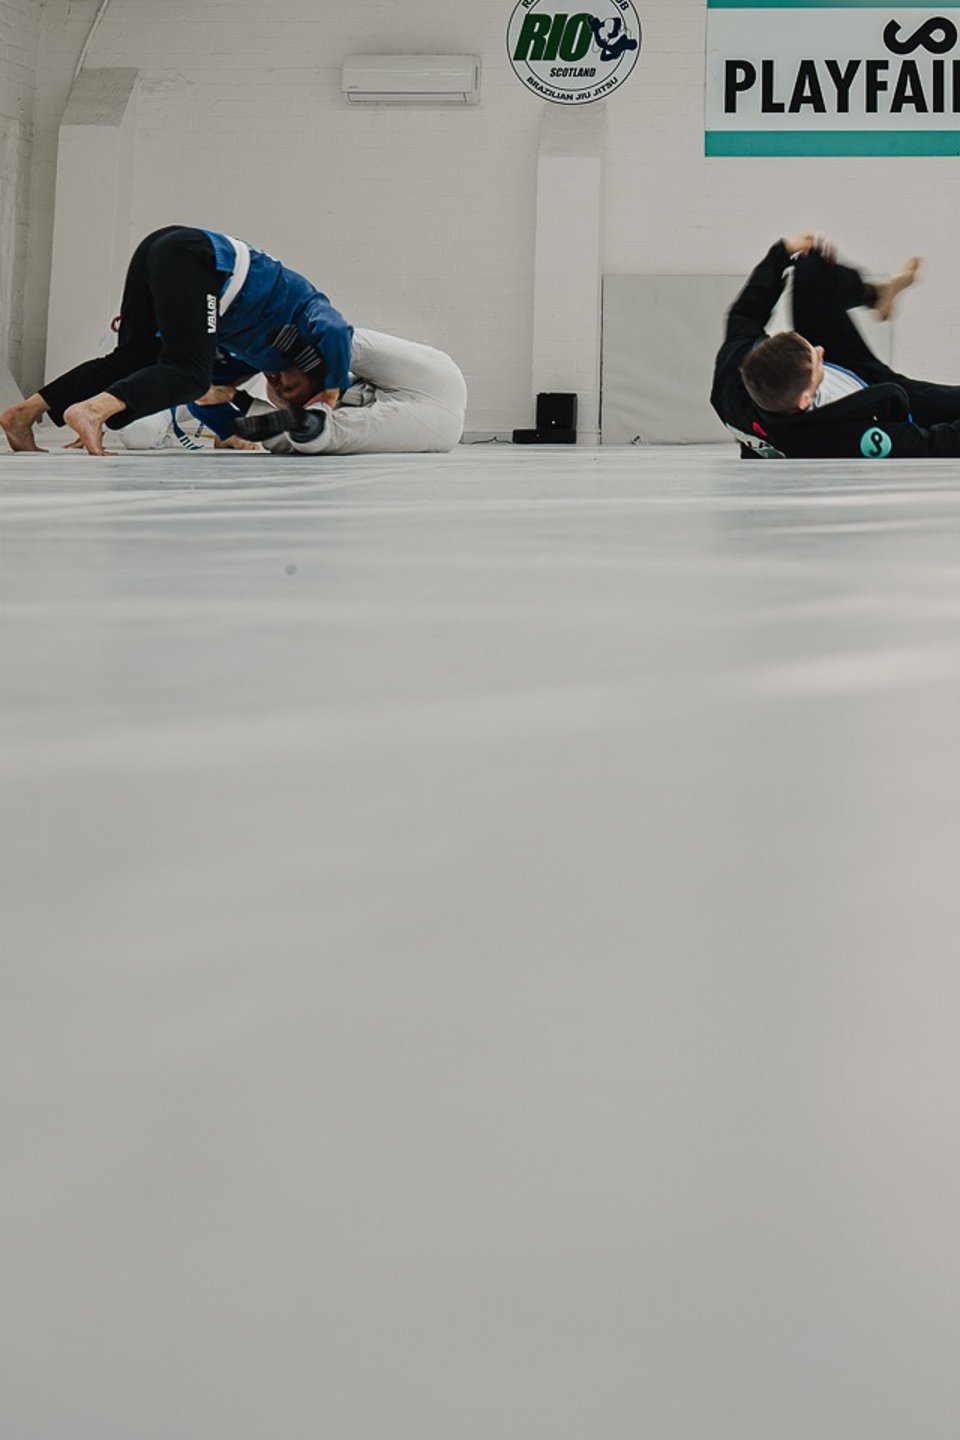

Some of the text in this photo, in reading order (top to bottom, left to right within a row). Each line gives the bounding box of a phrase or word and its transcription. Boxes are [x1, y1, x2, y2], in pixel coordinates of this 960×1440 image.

[512, 13, 594, 62] RIO
[549, 67, 597, 78] SCOTLAND
[526, 76, 619, 101] BRAZILIAN JIU JITSU
